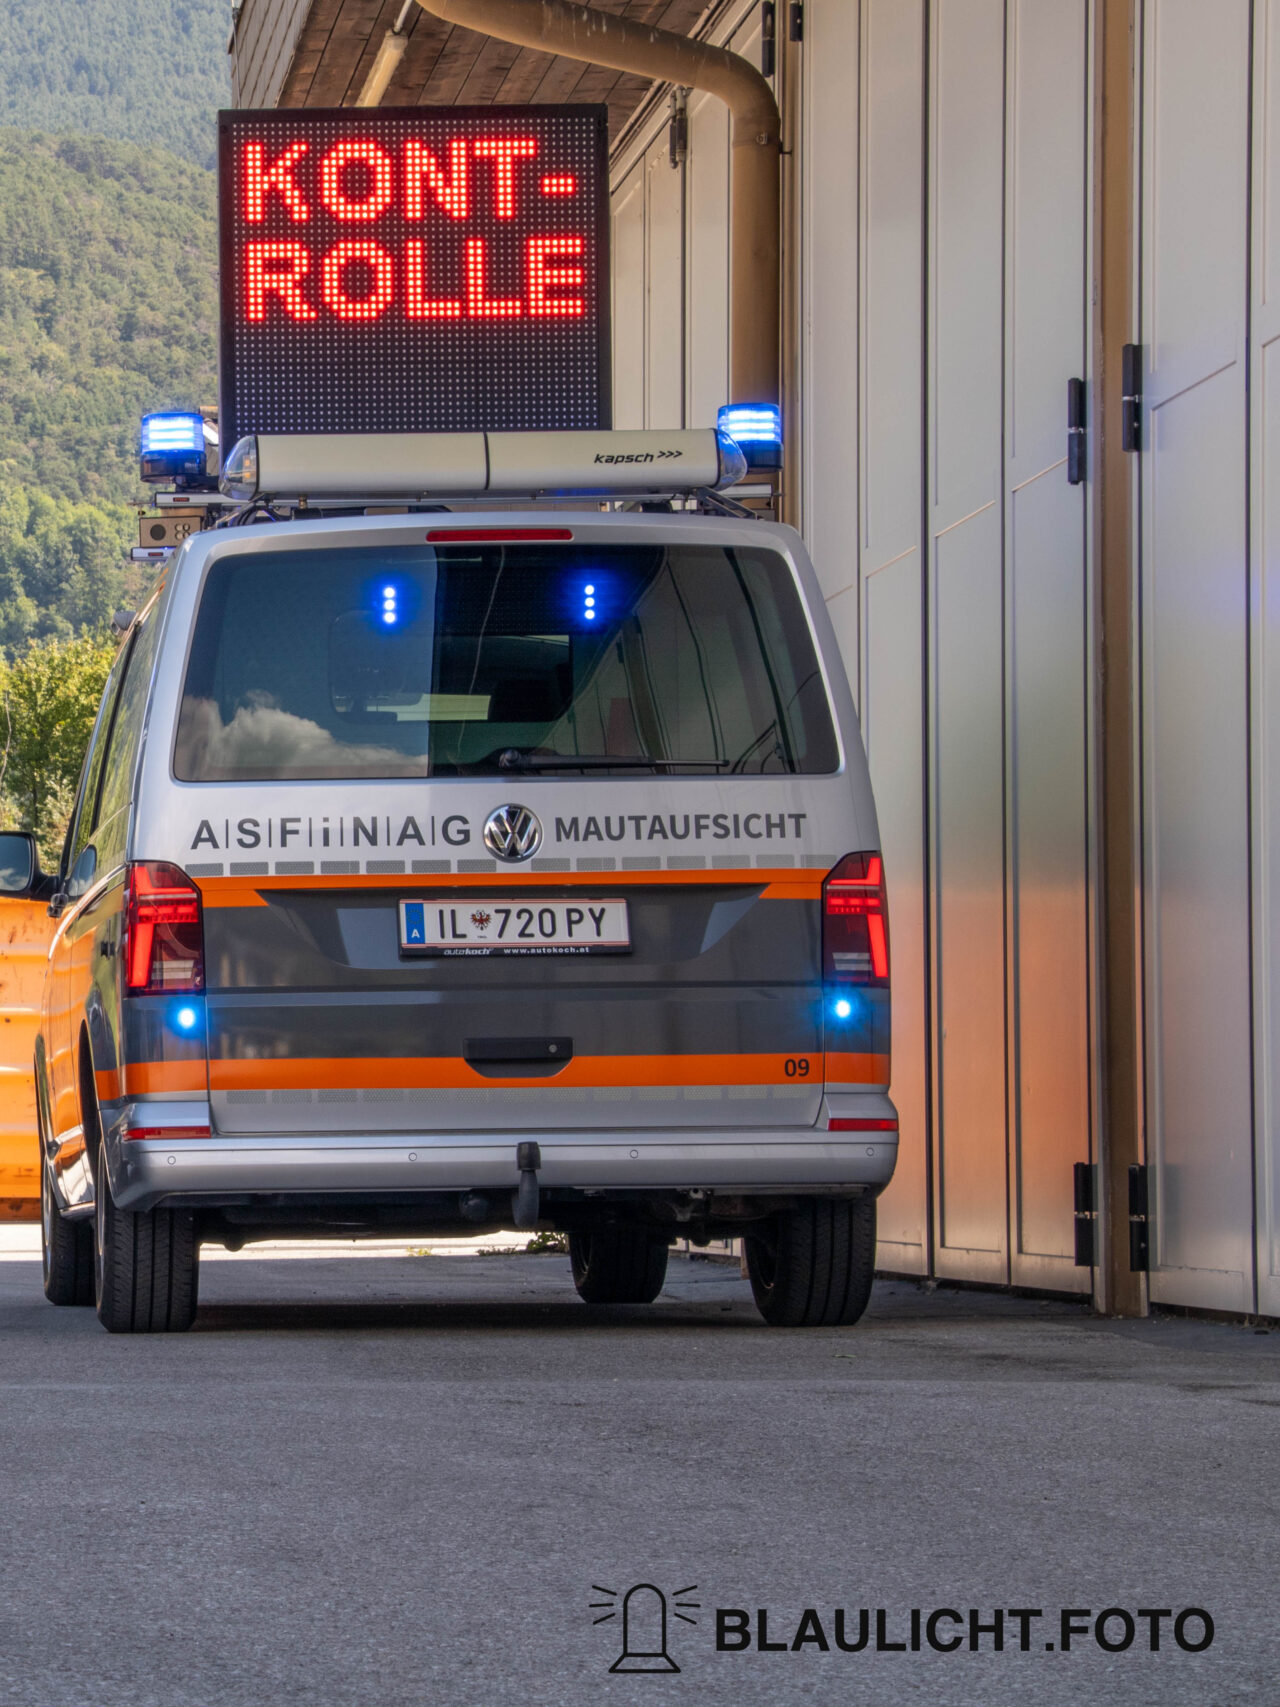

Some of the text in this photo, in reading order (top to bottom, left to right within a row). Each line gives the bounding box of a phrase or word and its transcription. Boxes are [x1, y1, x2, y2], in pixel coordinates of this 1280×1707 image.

[245, 139, 575, 222] KONT-
[247, 237, 583, 320] ROLLE
[594, 453, 654, 464] kapsch
[555, 813, 807, 844] MAUTAUFSICHT
[411, 928, 420, 938] A
[438, 907, 606, 939] IL 720 PY
[503, 946, 590, 954] www.autokoch.at
[784, 1058, 810, 1077] 09
